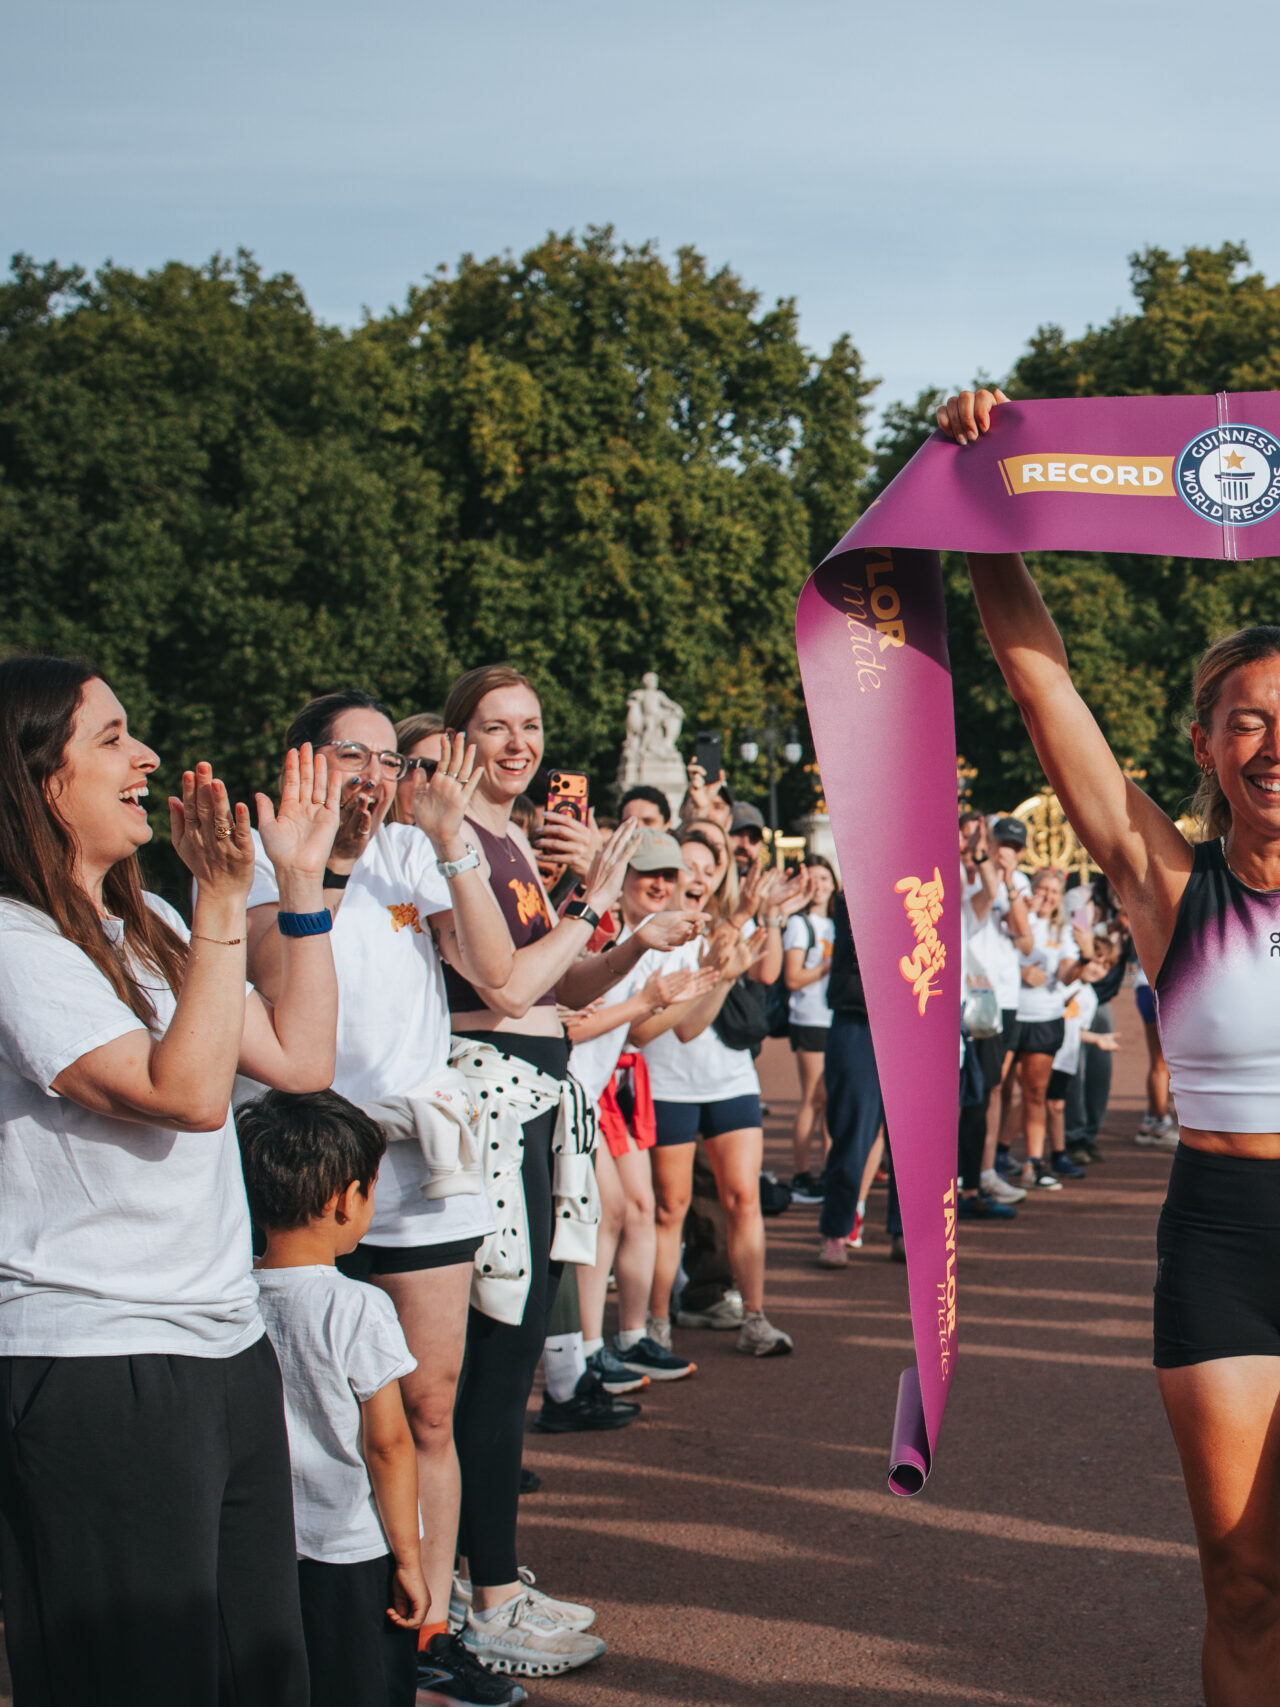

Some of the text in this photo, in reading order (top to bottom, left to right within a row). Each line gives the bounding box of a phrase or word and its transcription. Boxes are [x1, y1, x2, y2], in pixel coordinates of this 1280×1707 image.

[1191, 429, 1277, 458] GUINNESS
[1022, 462, 1164, 487] RECORD
[1183, 470, 1222, 517] WORLD
[943, 1179, 956, 1338] TAYLOR
